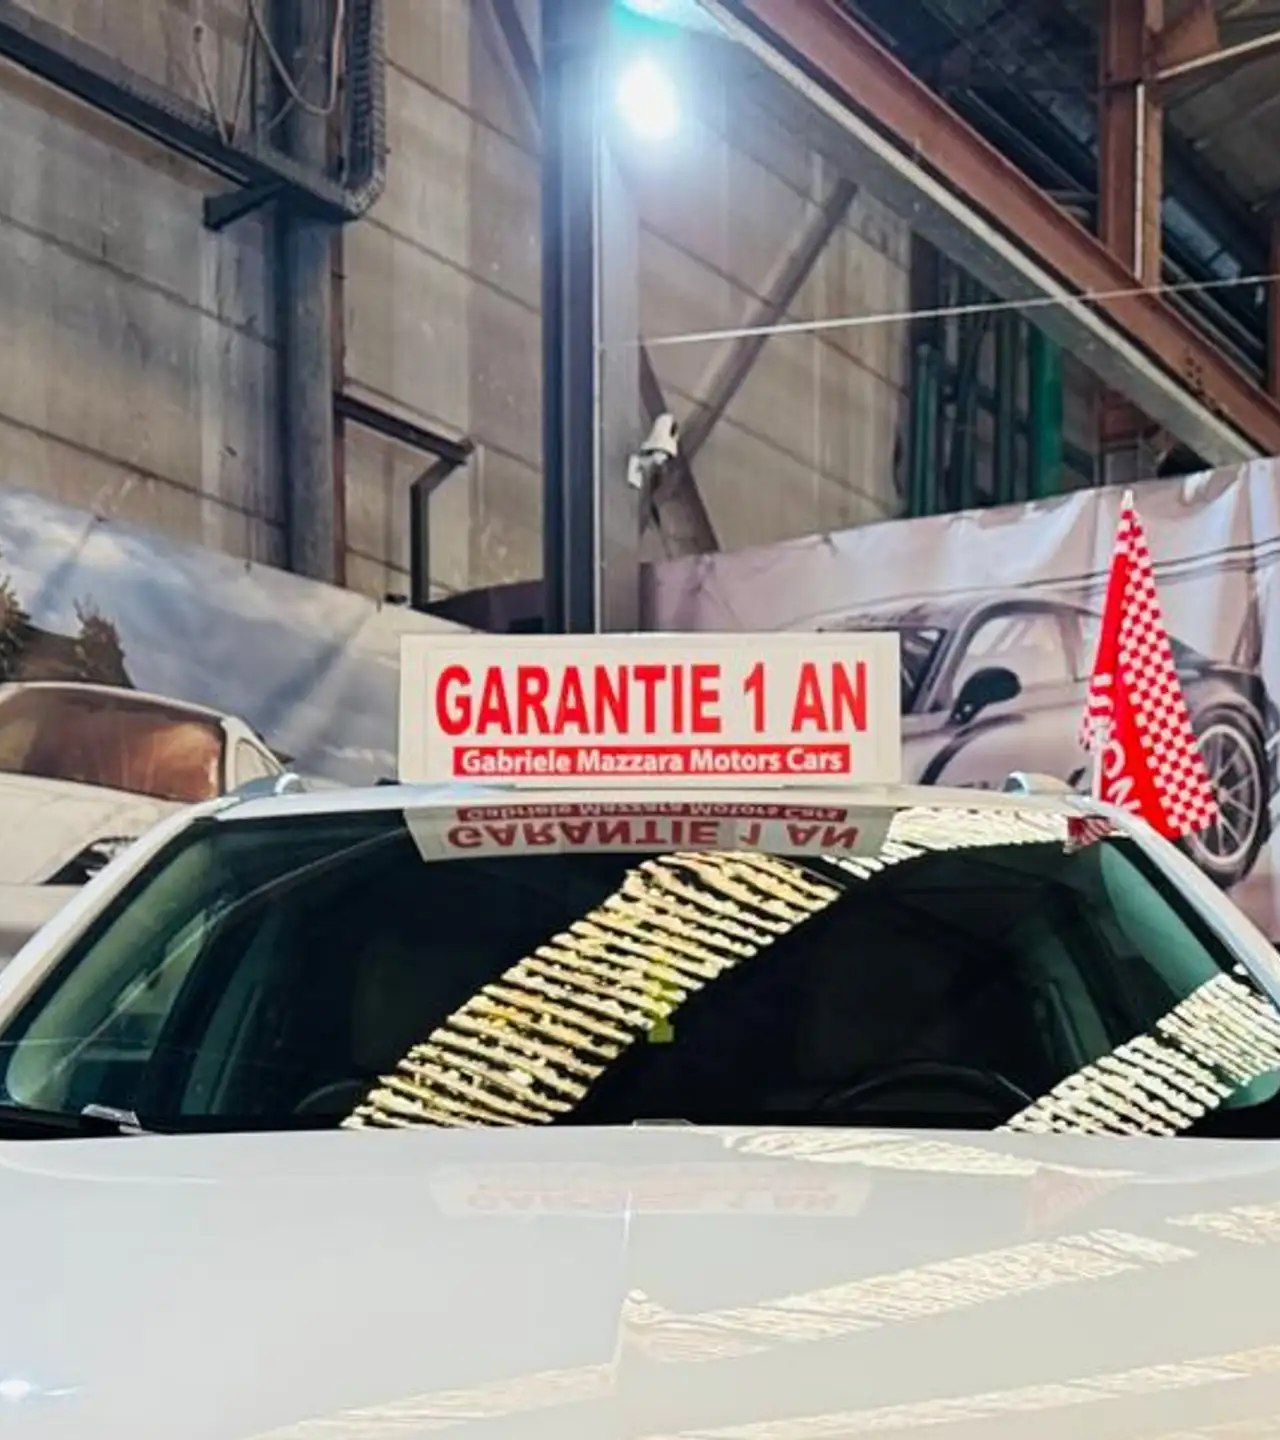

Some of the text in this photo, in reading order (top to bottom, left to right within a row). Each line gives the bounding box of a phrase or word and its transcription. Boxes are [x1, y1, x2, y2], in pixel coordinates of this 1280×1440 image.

[435, 660, 868, 736] GARANTIE 1 AN
[461, 746, 843, 775] Gabriele Mazzara Motors Cars
